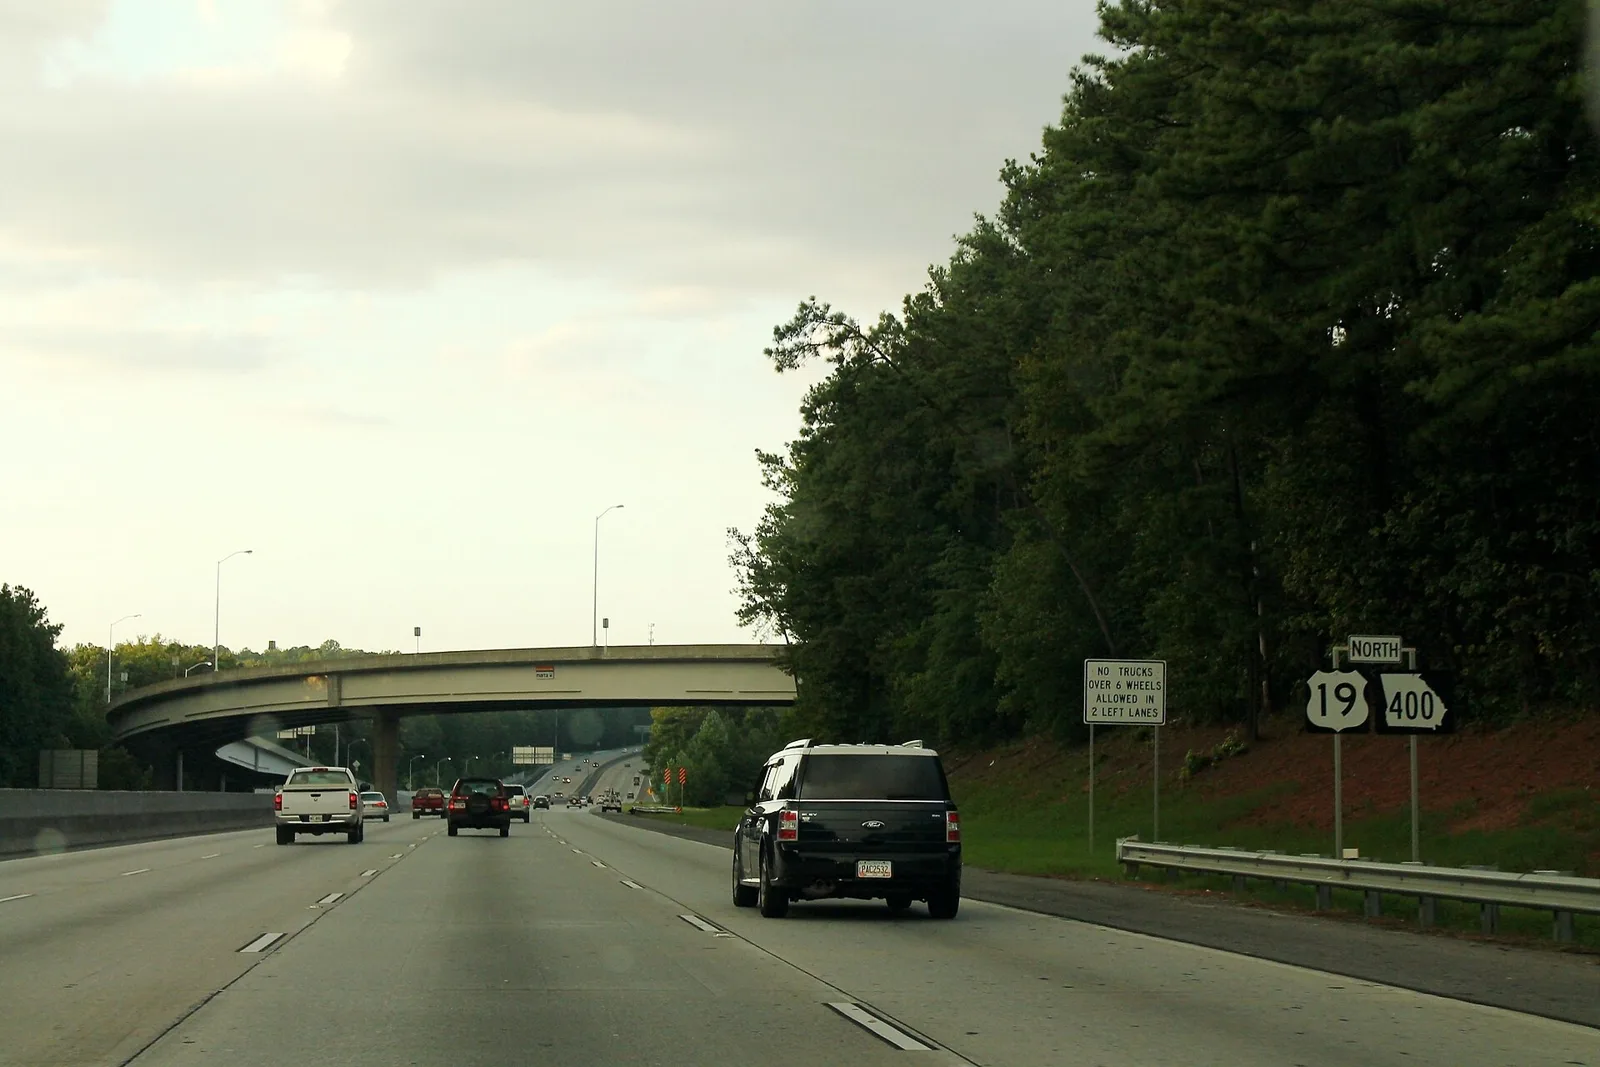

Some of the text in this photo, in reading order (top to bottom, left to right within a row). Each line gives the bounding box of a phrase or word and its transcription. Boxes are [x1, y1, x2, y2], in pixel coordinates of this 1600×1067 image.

[1352, 640, 1398, 658] NORTH
[1097, 666, 1153, 677] NO TRUCKS
[1088, 680, 1162, 690] OVER 6 WHEELS
[1096, 694, 1154, 704] ALLOWED IN
[1317, 682, 1356, 717] 19
[1389, 690, 1434, 720] 400
[1091, 707, 1158, 718] 2 LEFT LANES
[861, 865, 889, 874] PAC2532
